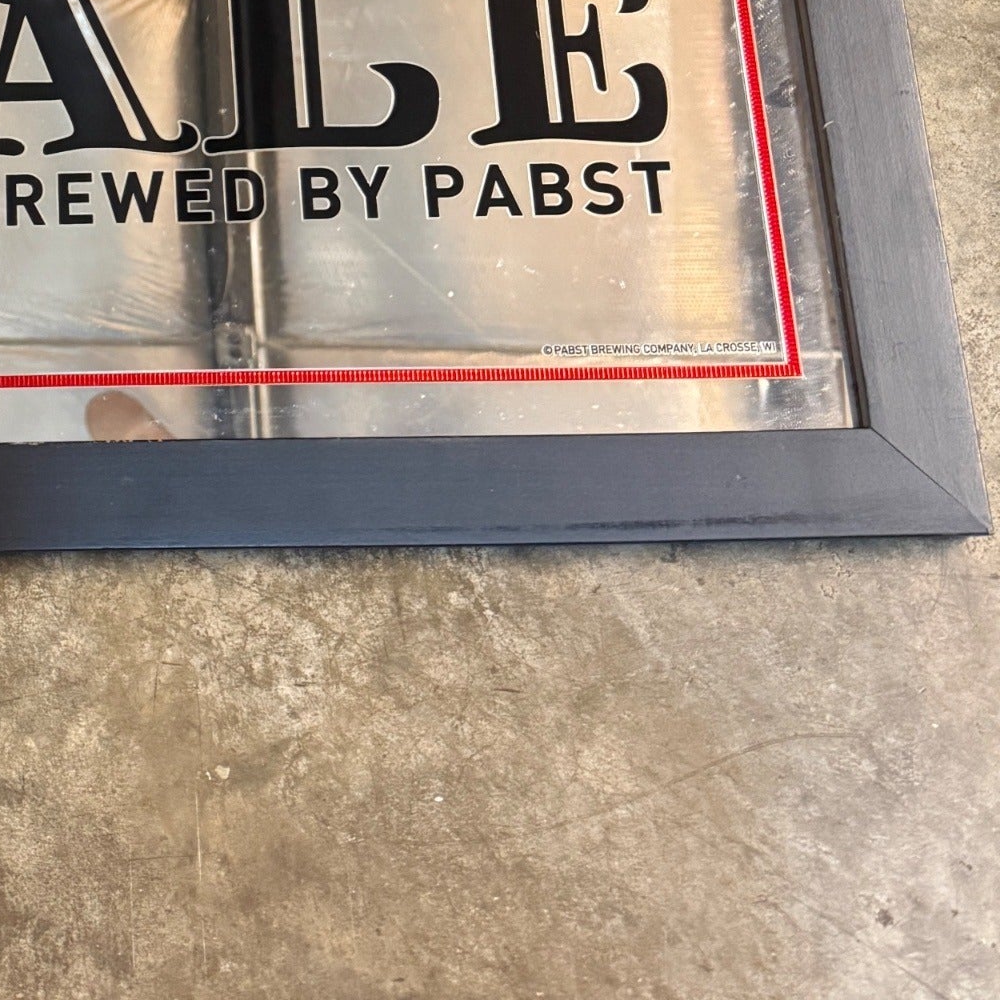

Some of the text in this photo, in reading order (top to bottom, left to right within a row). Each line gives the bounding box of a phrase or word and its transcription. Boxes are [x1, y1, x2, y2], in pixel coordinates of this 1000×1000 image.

[300, 166, 390, 220] BY
[424, 160, 671, 219] PABST
[591, 344, 640, 354] BREWING
[700, 343, 713, 352] LA
[763, 342, 776, 351] WI
